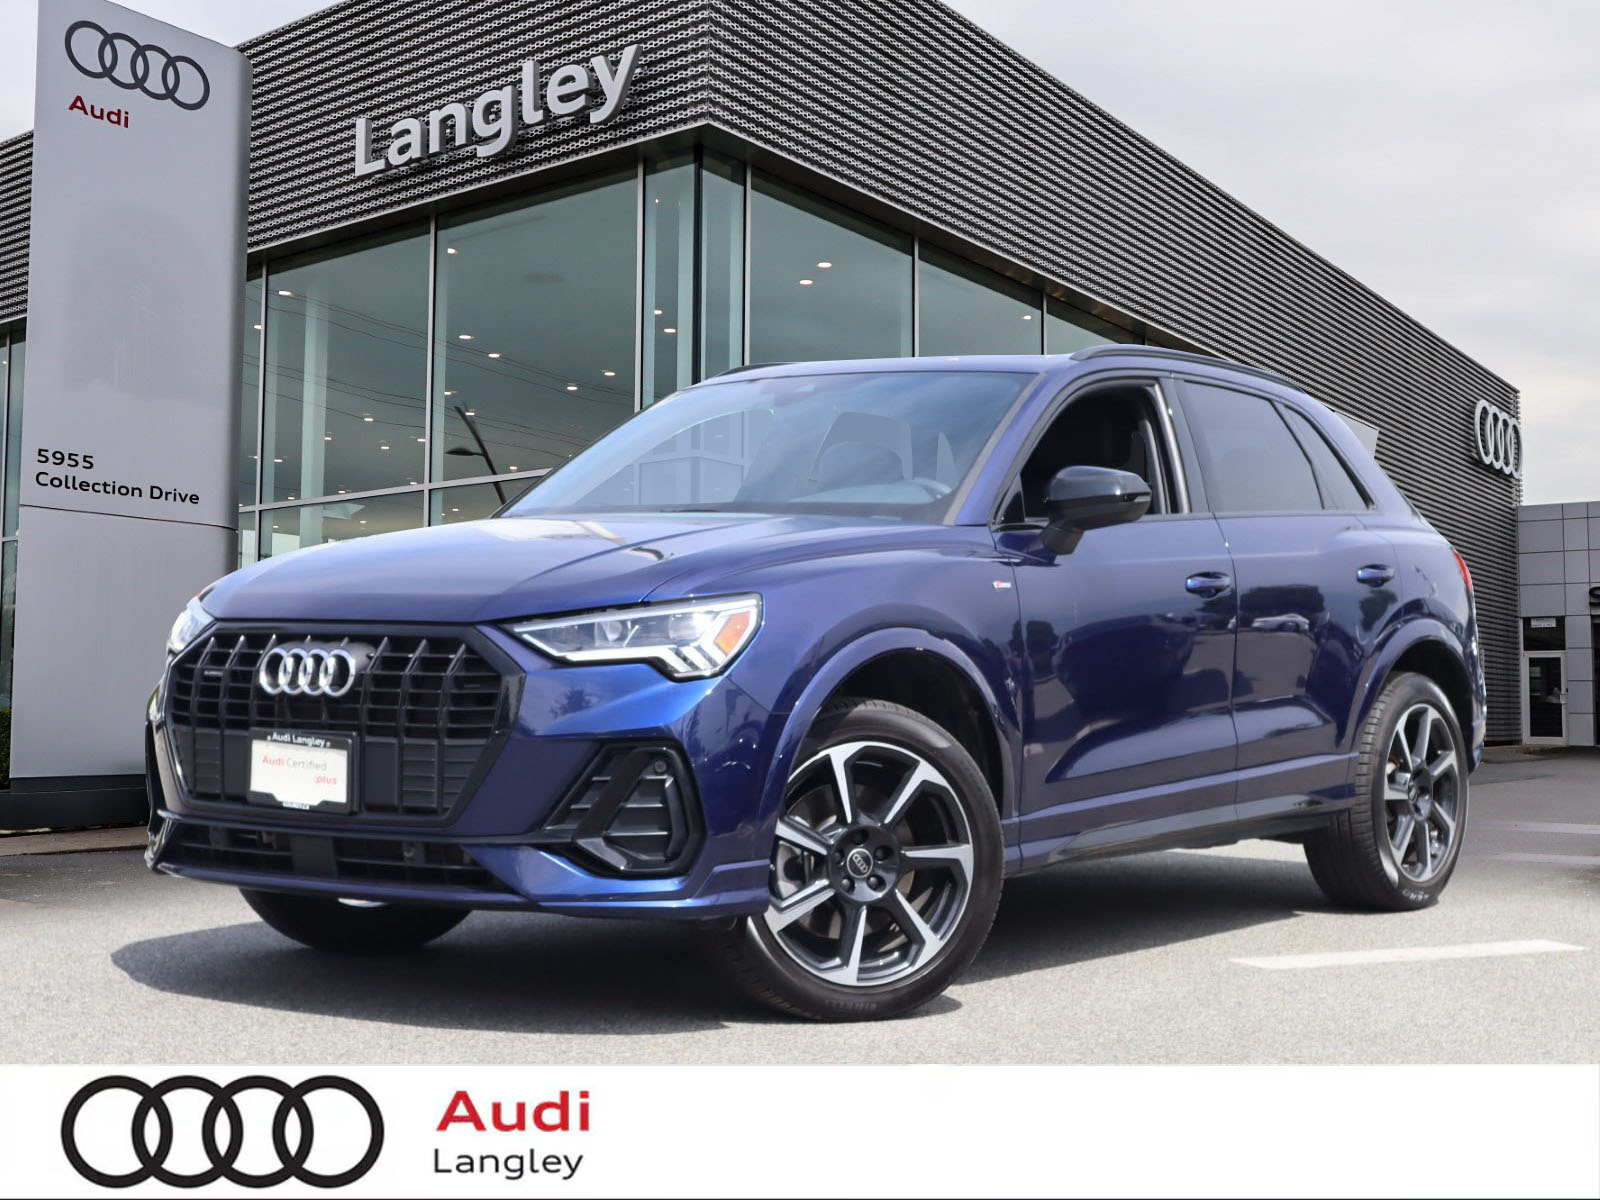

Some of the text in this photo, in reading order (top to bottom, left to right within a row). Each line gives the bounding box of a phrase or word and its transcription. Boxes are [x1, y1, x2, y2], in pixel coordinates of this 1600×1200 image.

[68, 95, 129, 129] Audi
[354, 43, 644, 177] Langley
[36, 448, 94, 470] 5955
[35, 471, 200, 504] Collection Drive
[272, 732, 326, 748] Audi Langley
[262, 755, 327, 771] Audi Certified
